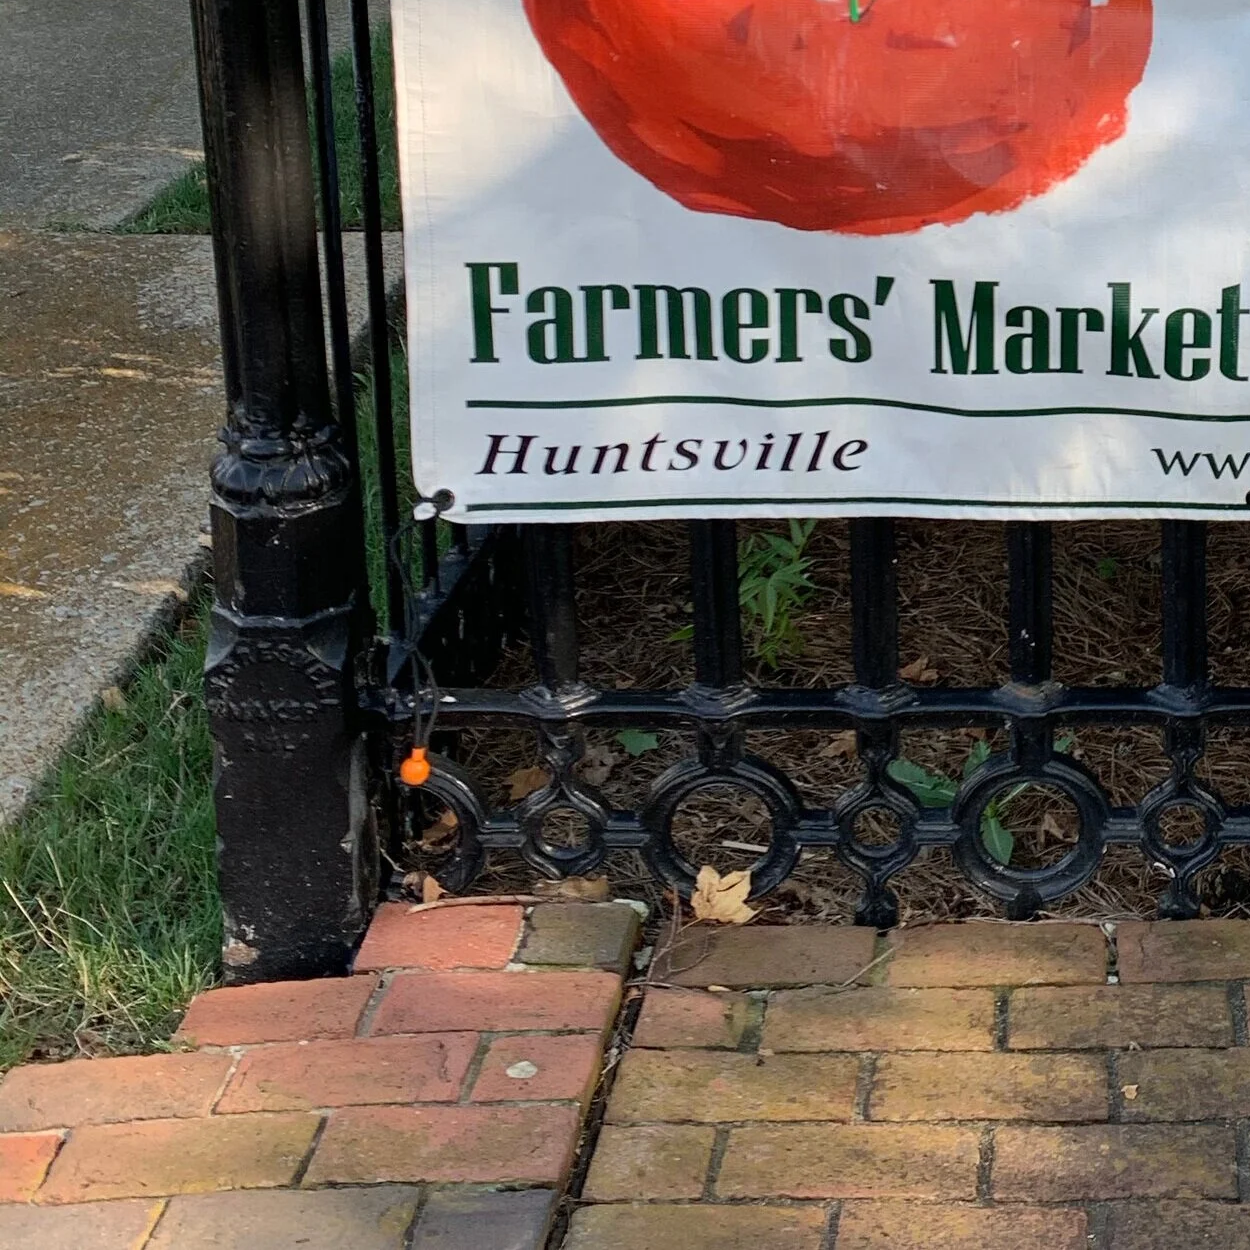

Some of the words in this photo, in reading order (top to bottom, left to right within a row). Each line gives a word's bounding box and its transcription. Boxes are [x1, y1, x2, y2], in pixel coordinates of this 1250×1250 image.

[465, 262, 895, 364] Farmers'
[930, 279, 1250, 382] Market
[476, 431, 869, 476] Huntsville
